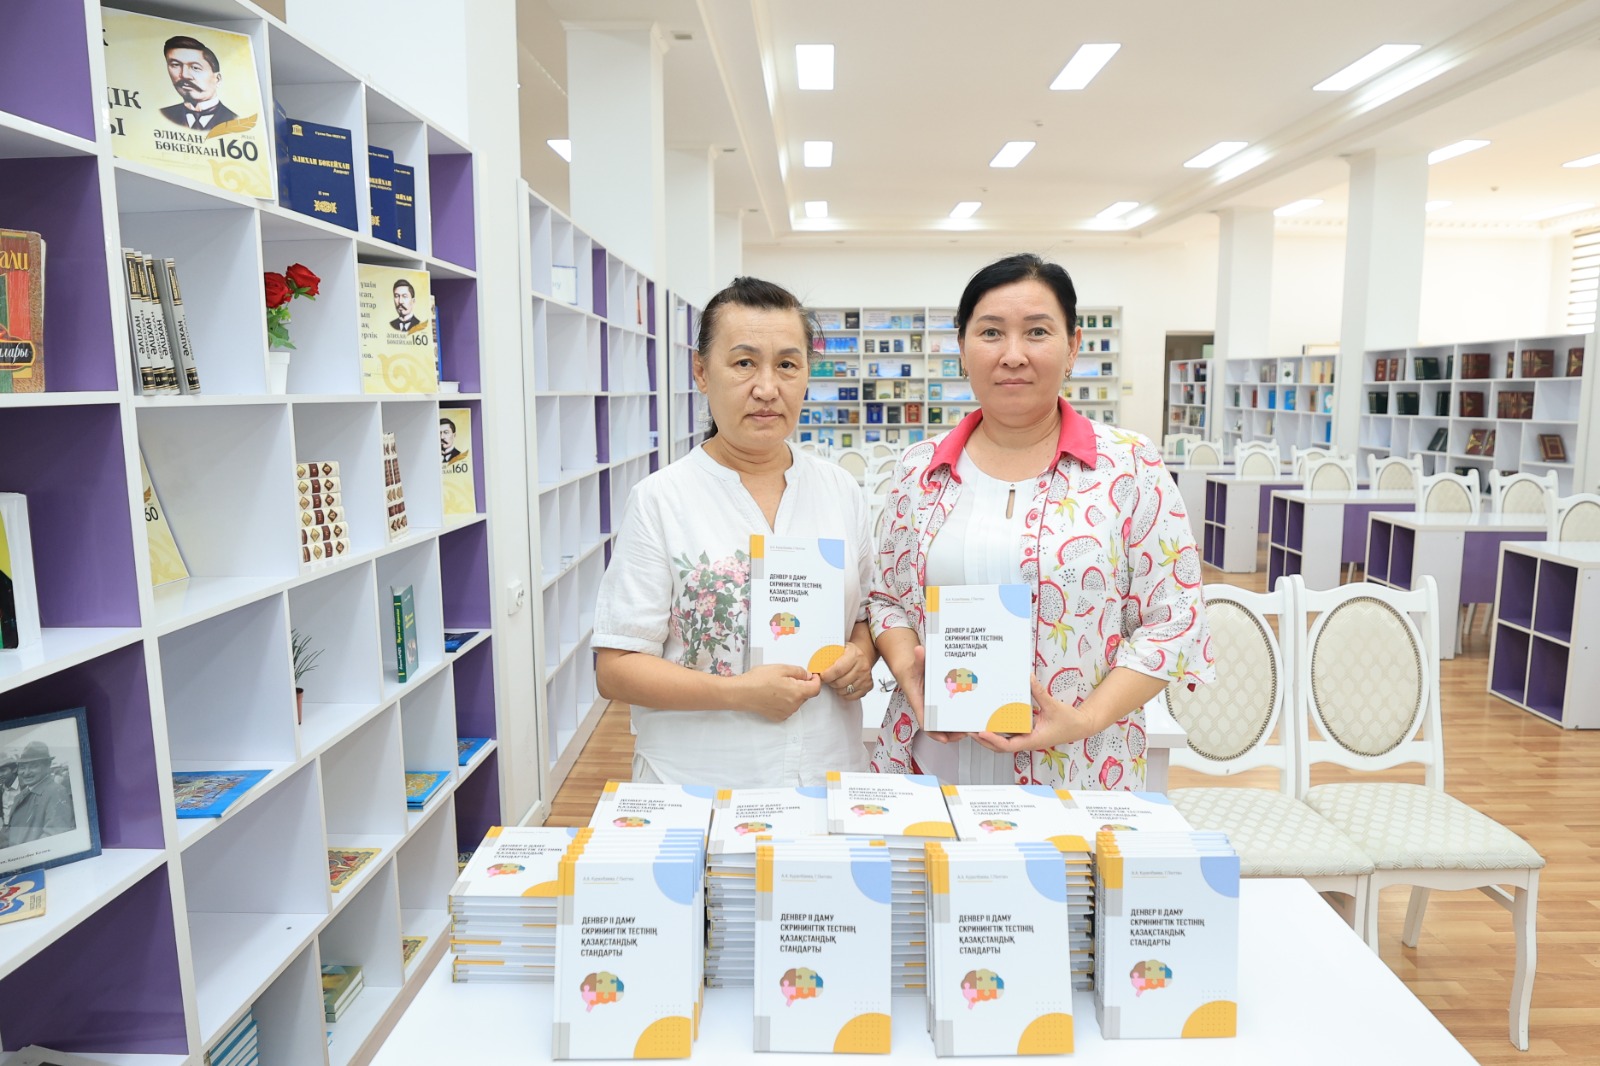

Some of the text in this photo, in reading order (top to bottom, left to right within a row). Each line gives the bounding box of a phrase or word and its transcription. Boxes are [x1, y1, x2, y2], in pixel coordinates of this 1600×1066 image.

[107, 87, 141, 109] ІК
[154, 130, 202, 143] ӘЛИХАН
[155, 140, 218, 156] БӨКЕЙХАН
[218, 138, 258, 161] 160
[135, 316, 145, 354] ӘЛИХАН
[145, 318, 157, 355] ӘЛИХАН
[156, 320, 168, 356] ӘЛИХАН
[178, 321, 189, 356] ӘЛИХАН
[412, 335, 428, 345] 160
[453, 463, 468, 473] 160
[615, 917, 635, 925] ДАМУ
[959, 915, 984, 923] ДЕНВЕР
[992, 914, 1011, 923] ДАМУ
[629, 928, 658, 936] ТЕСТІНІҢ
[827, 925, 856, 933] ТЕСТІНІҢ
[1005, 925, 1034, 933] ТЕСТІНІҢ
[581, 938, 637, 947] ҚАЗАҚСТАНДЫҚ
[780, 934, 836, 944] ҚАЗАҚСТАНДЫҚ
[780, 945, 821, 953] СТАНДАРТЫ
[960, 947, 1000, 955] СТАНДАРТЫ
